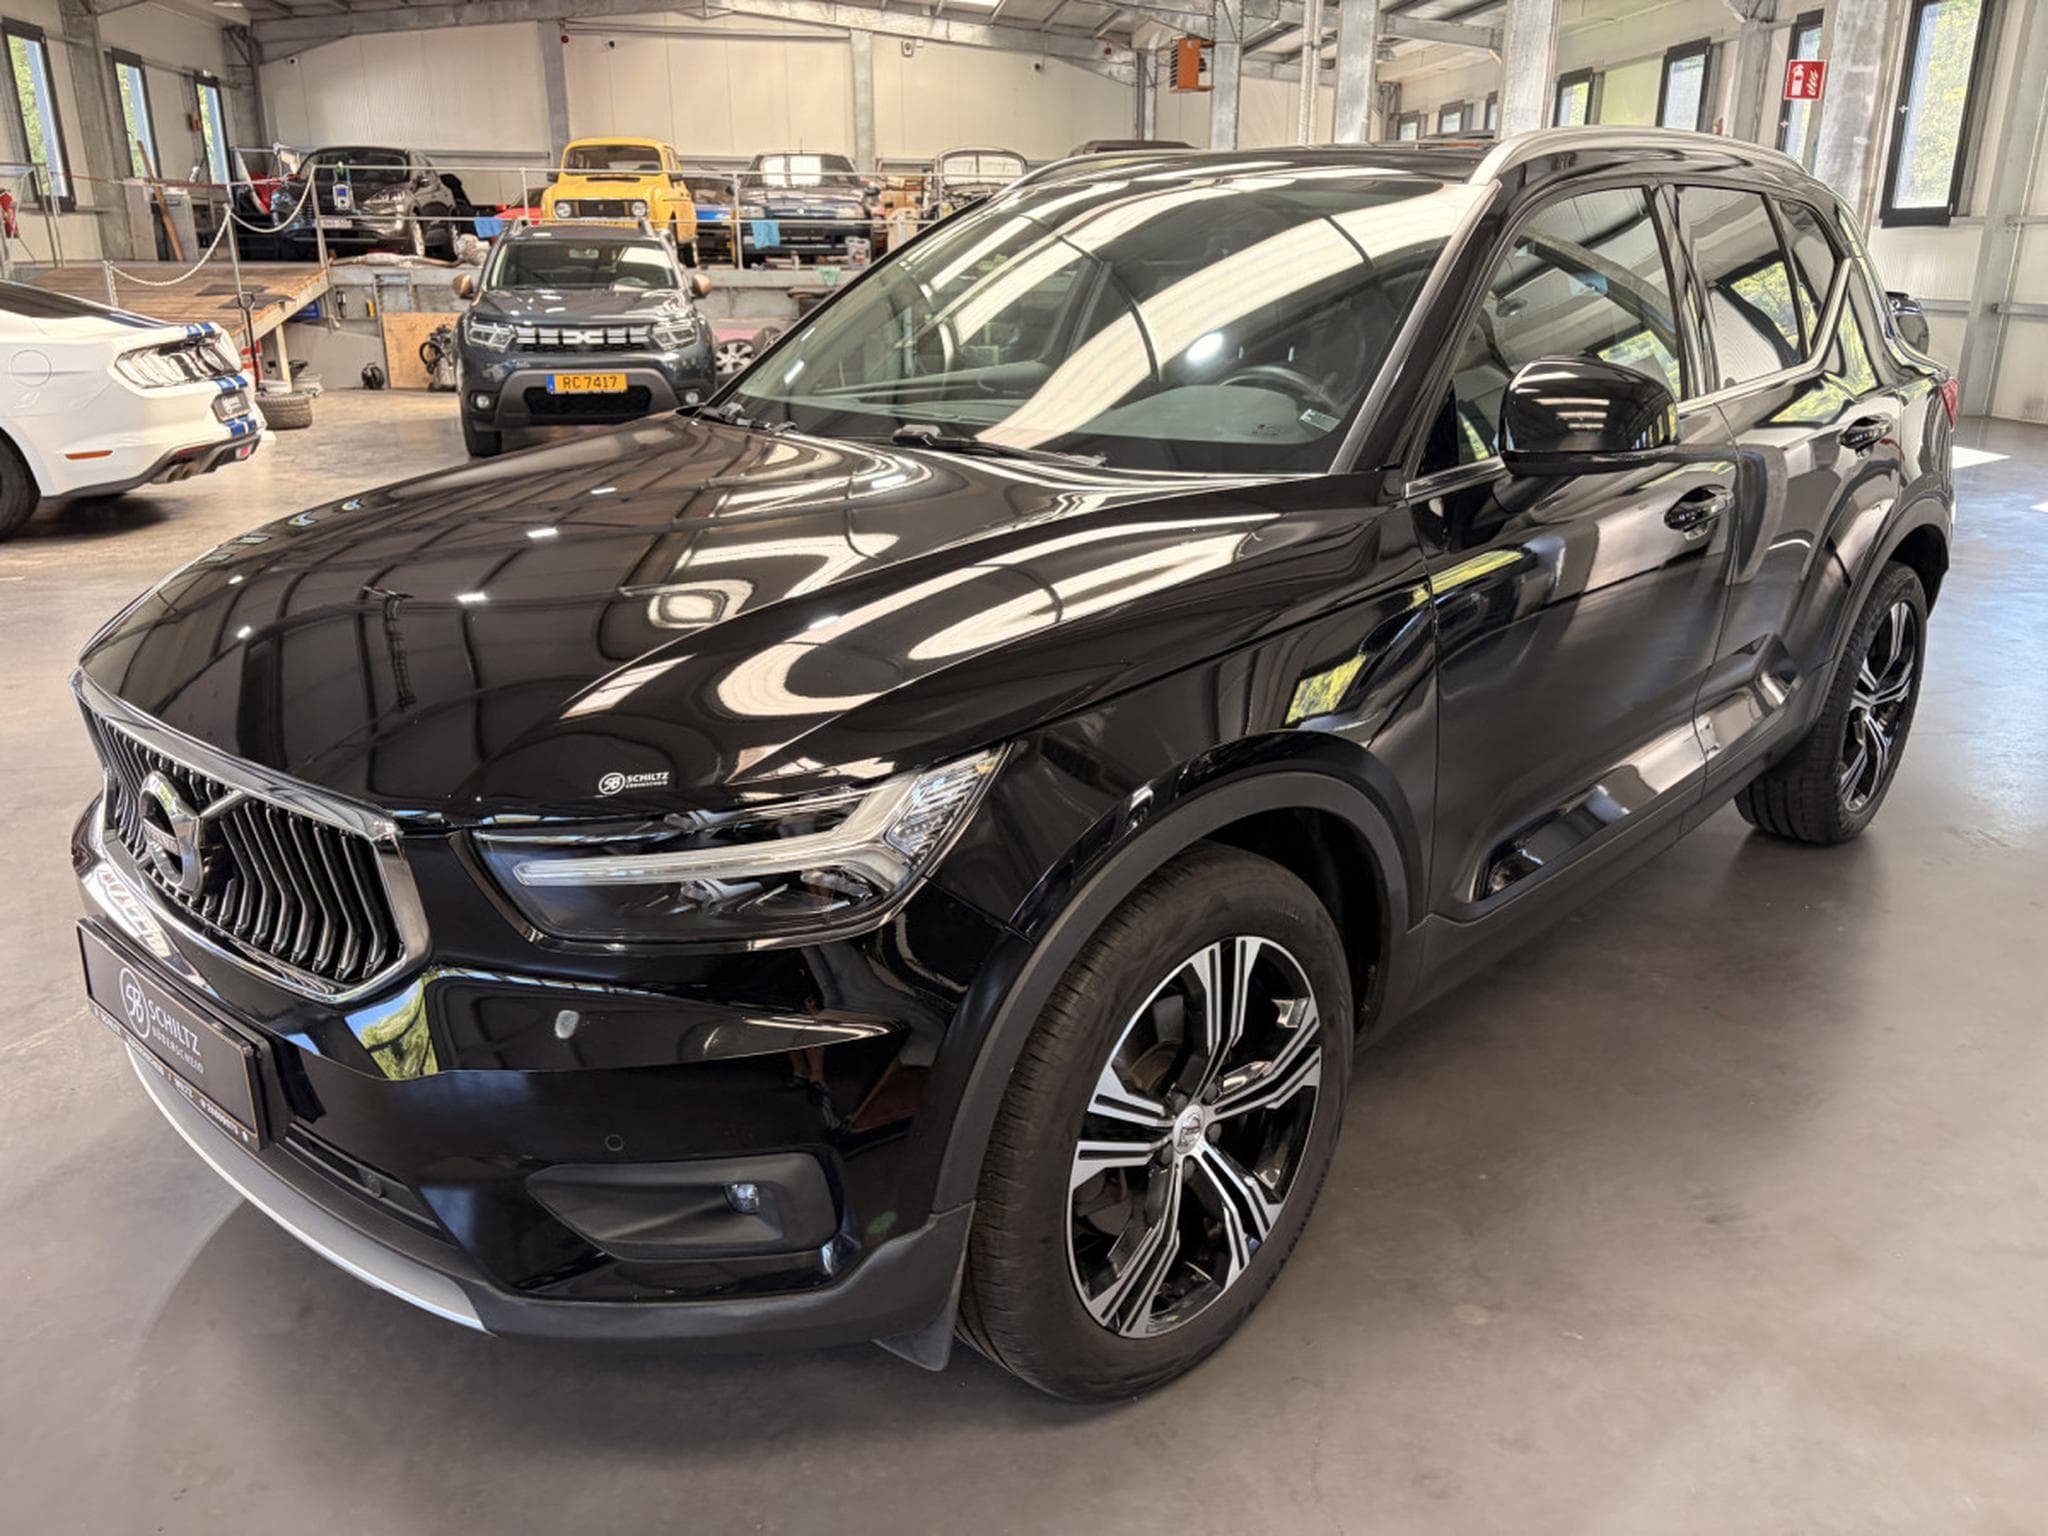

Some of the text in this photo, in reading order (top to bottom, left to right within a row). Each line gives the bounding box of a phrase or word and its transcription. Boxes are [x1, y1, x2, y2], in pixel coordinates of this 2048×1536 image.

[562, 375, 617, 389] RC 7417
[626, 771, 670, 783] SCHILTZ
[148, 999, 201, 1057] SCHILTZ
